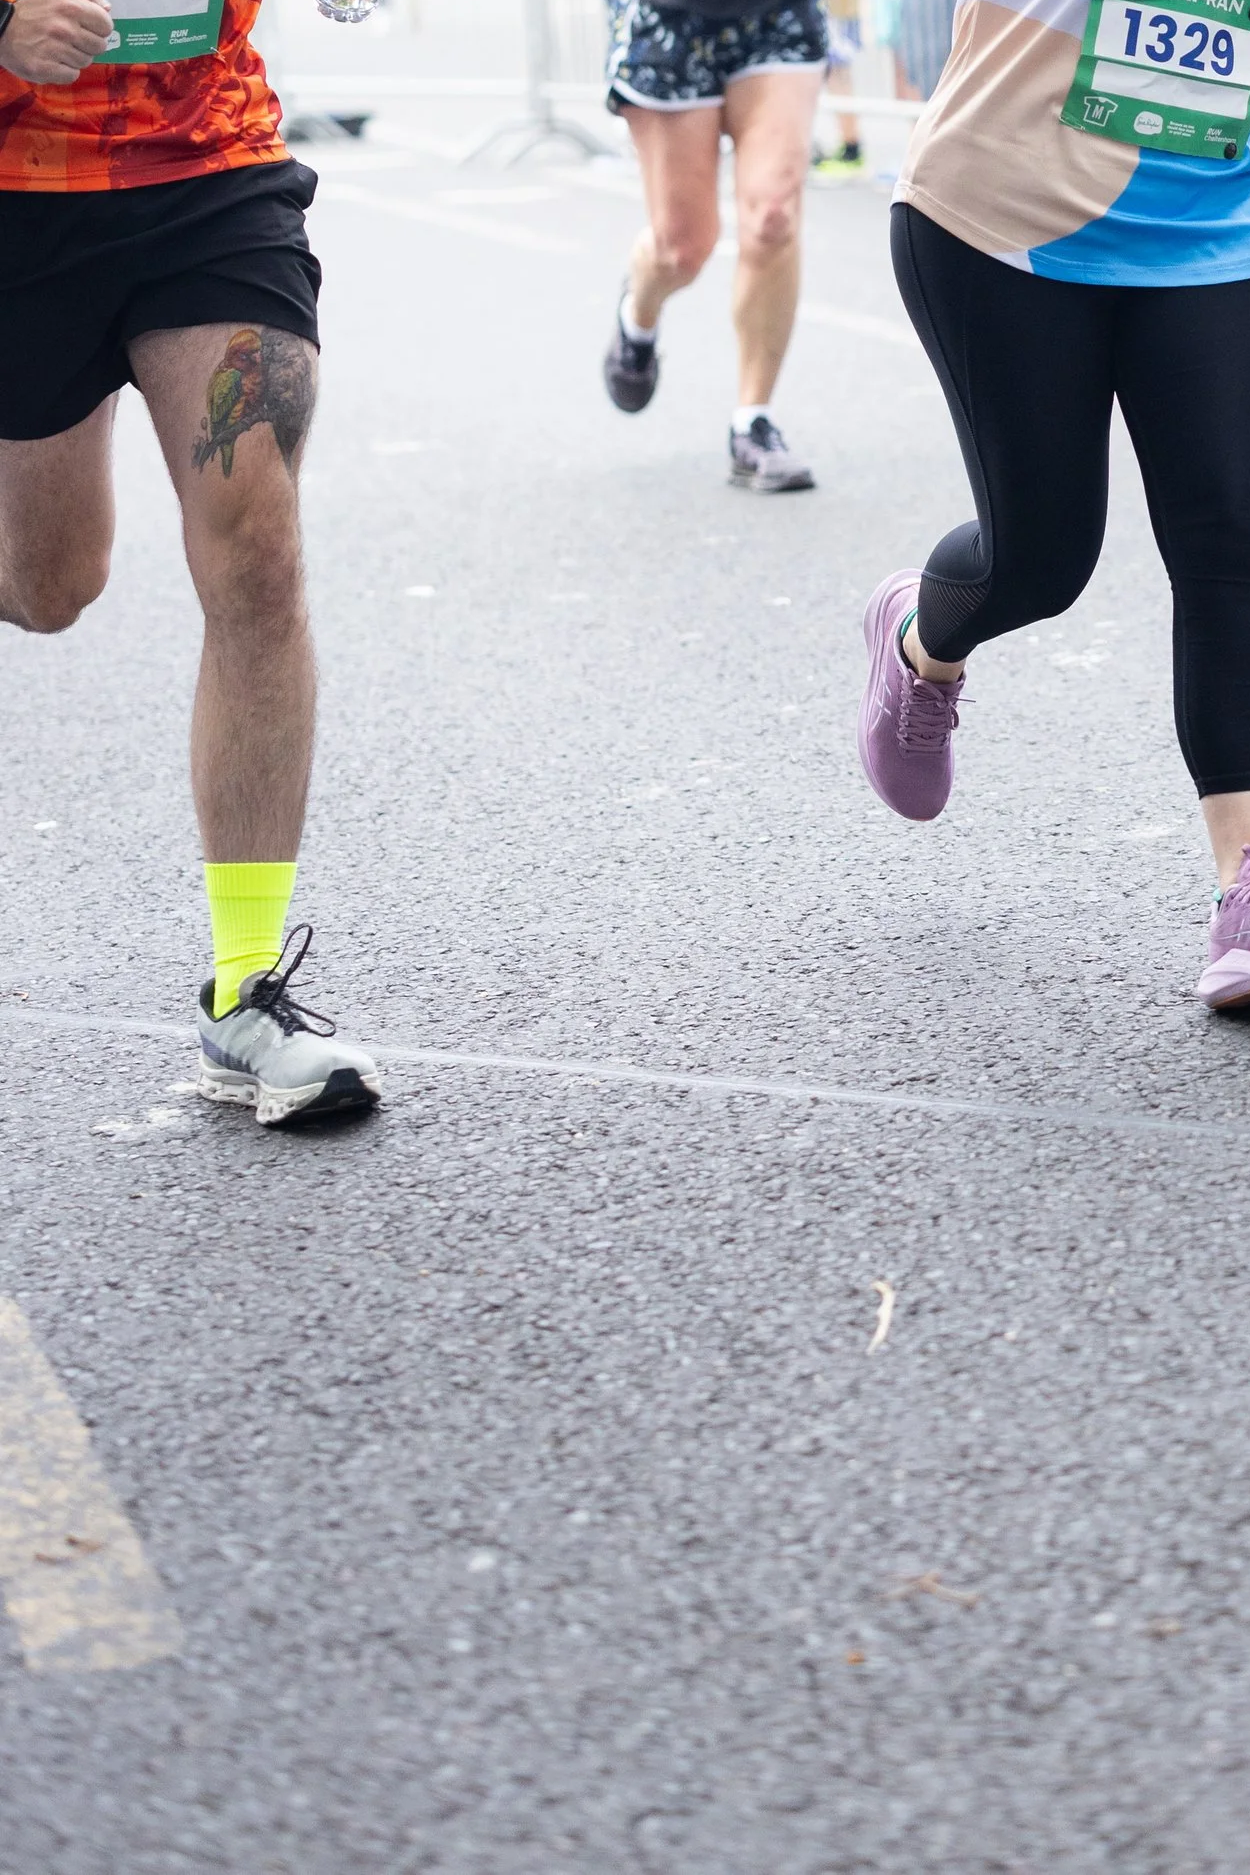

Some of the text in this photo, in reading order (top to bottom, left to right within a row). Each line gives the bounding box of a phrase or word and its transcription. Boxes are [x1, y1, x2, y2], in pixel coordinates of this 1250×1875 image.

[170, 29, 189, 39] RUN
[1123, 7, 1235, 76] 1329
[1092, 106, 1104, 120] M
[1206, 127, 1223, 137] RUN
